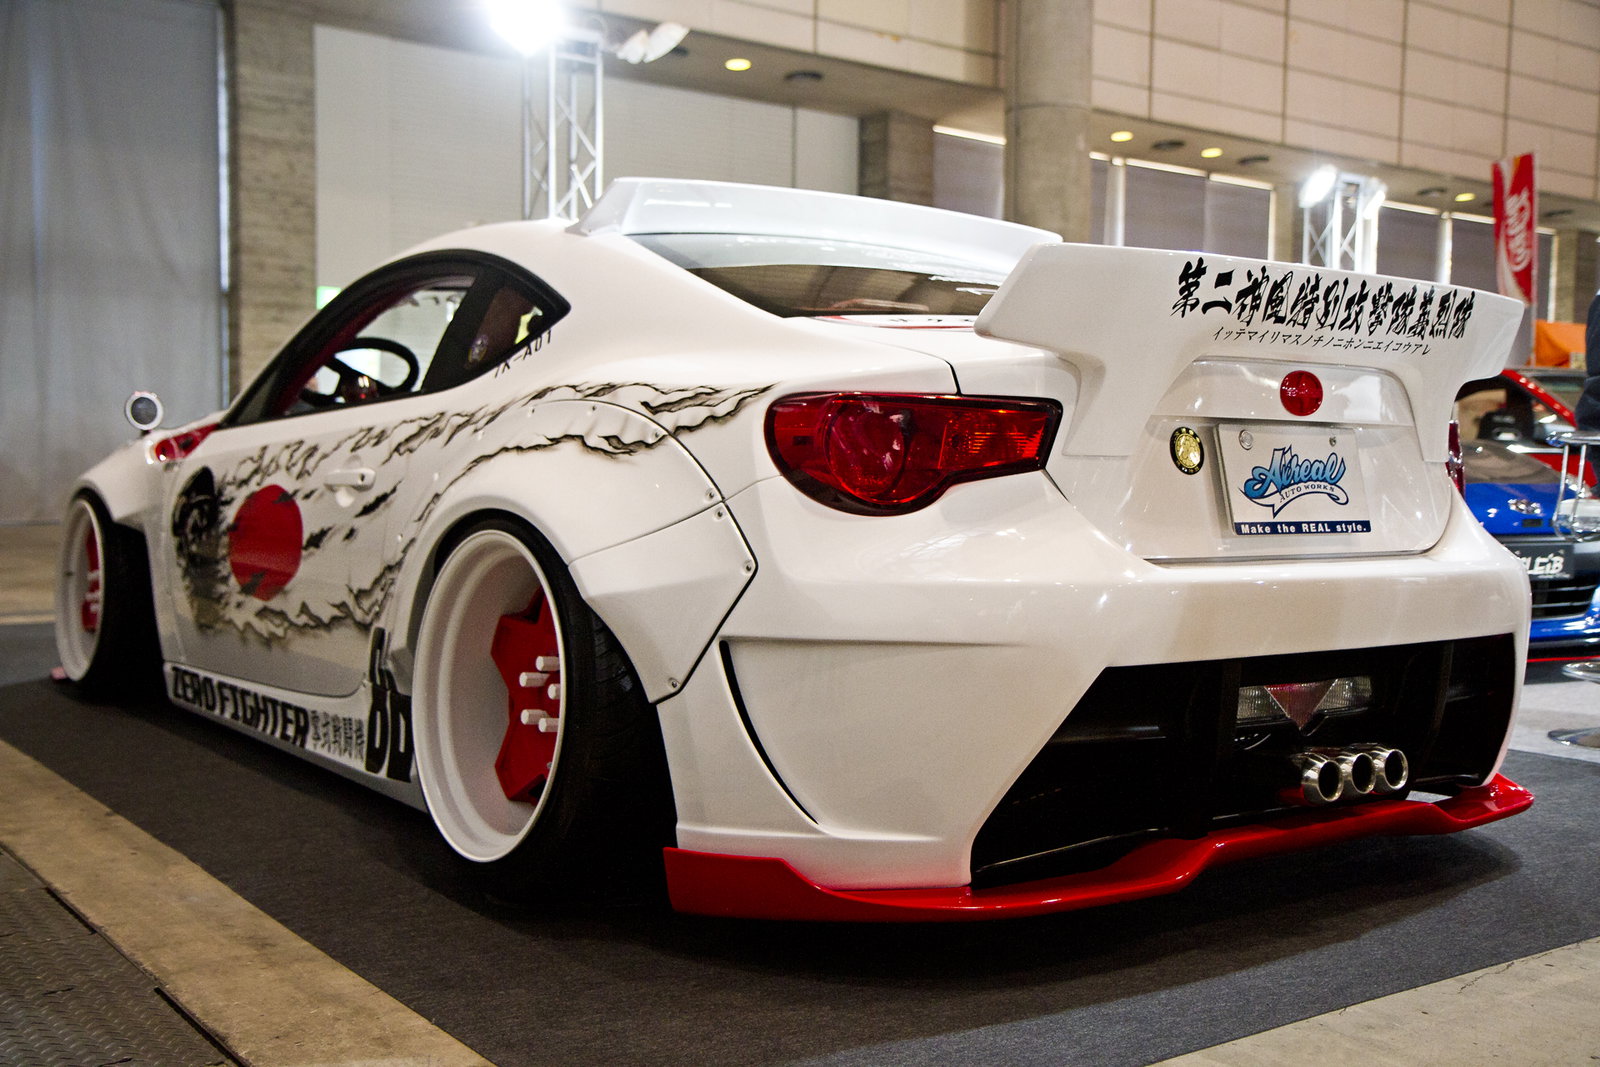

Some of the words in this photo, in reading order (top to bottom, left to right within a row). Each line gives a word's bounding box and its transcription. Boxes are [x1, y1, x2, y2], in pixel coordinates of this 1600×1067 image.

[1279, 485, 1302, 503] AUTO
[1304, 482, 1336, 493] WORKS
[1240, 523, 1271, 534] Make
[1277, 523, 1296, 533] the
[1302, 522, 1331, 533] REAL
[1336, 521, 1367, 533] style.
[172, 666, 216, 712] ZERO
[217, 680, 310, 749] FIGHTER
